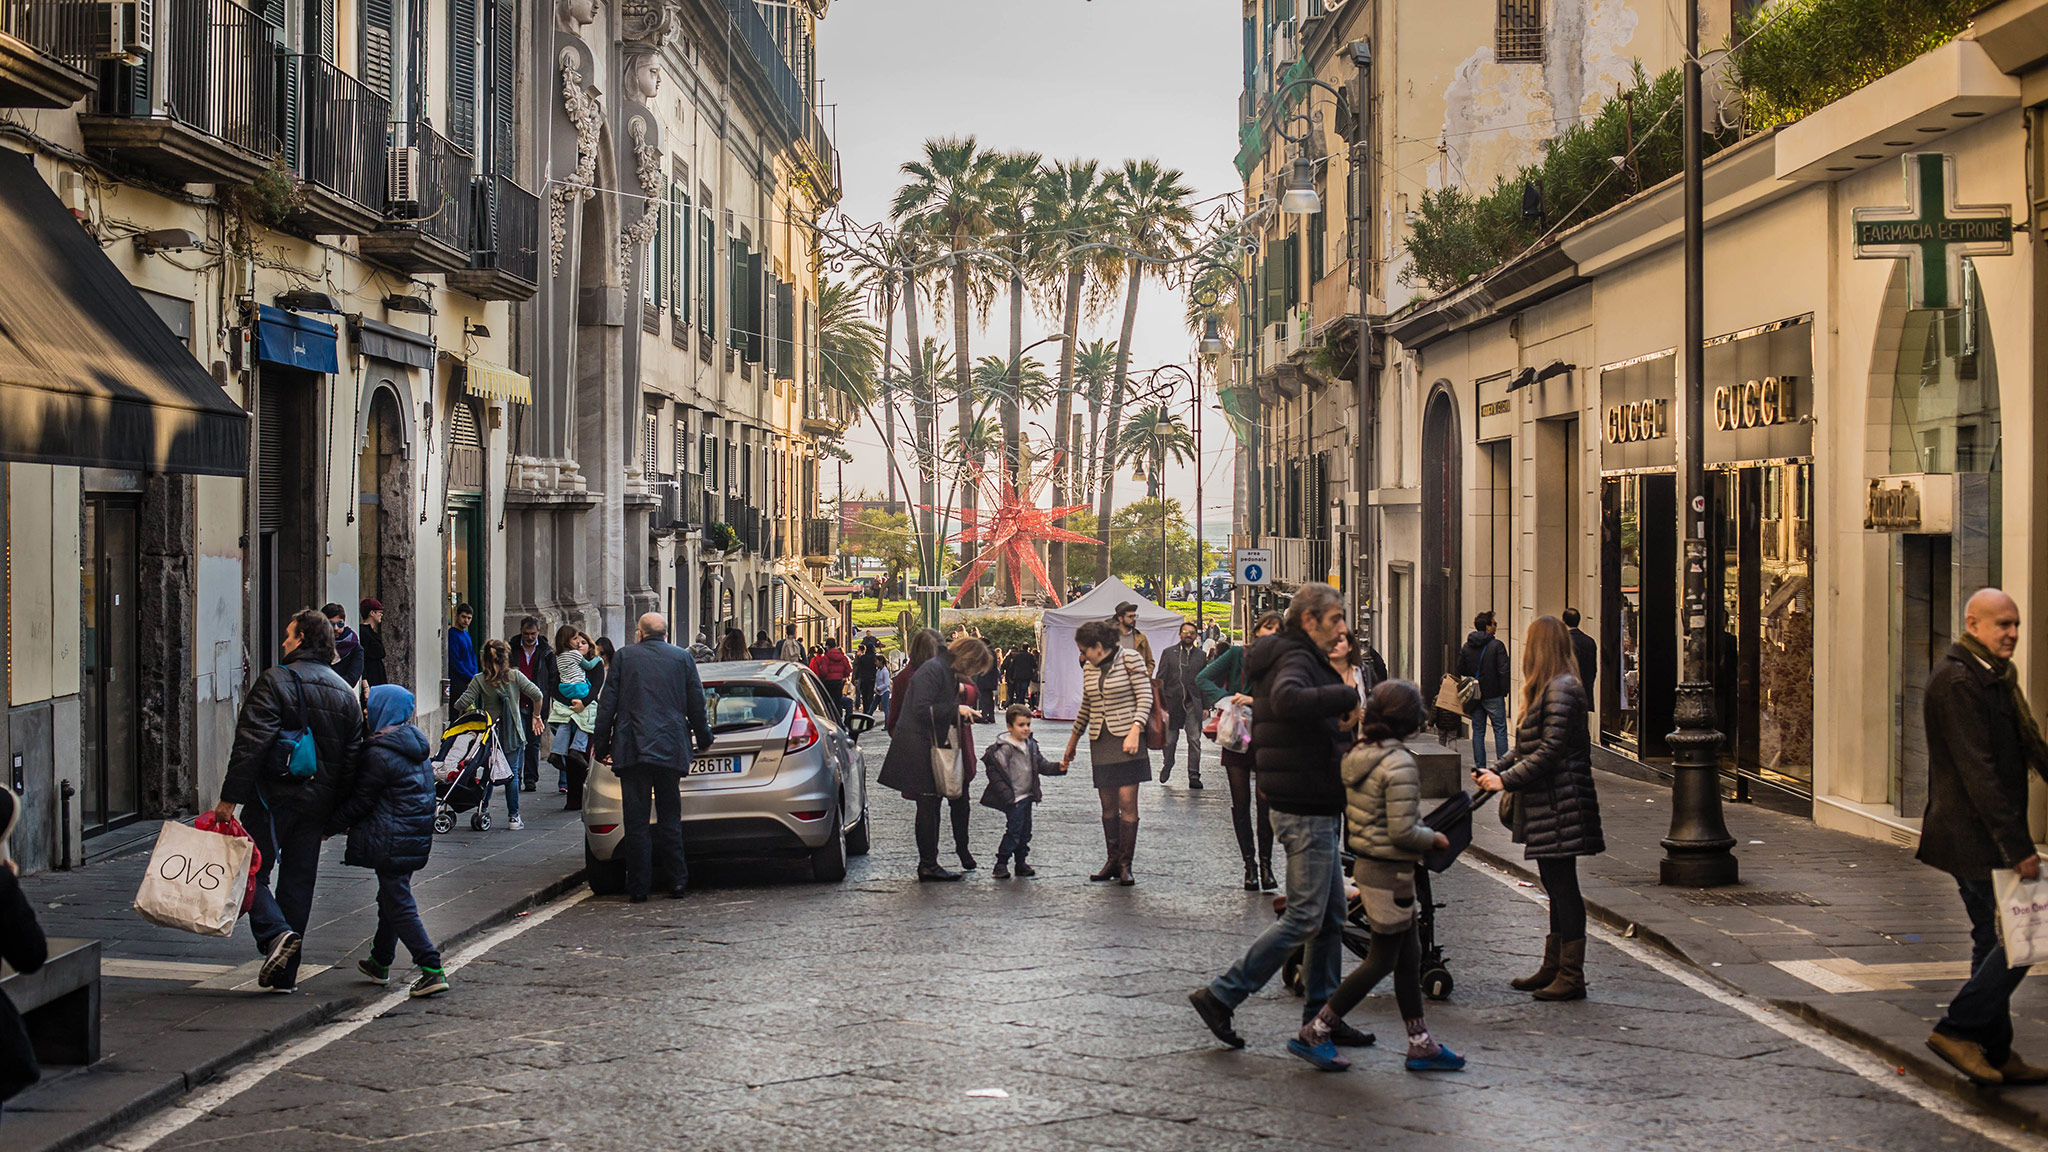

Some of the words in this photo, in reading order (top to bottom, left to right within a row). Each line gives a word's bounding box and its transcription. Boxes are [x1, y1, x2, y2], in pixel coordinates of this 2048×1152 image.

[1863, 223, 1934, 242] FARMACIA
[1714, 375, 1798, 431] GUCCI
[1607, 399, 1667, 444] GUCCI
[690, 758, 732, 774] 286TR
[160, 854, 225, 890] OVS
